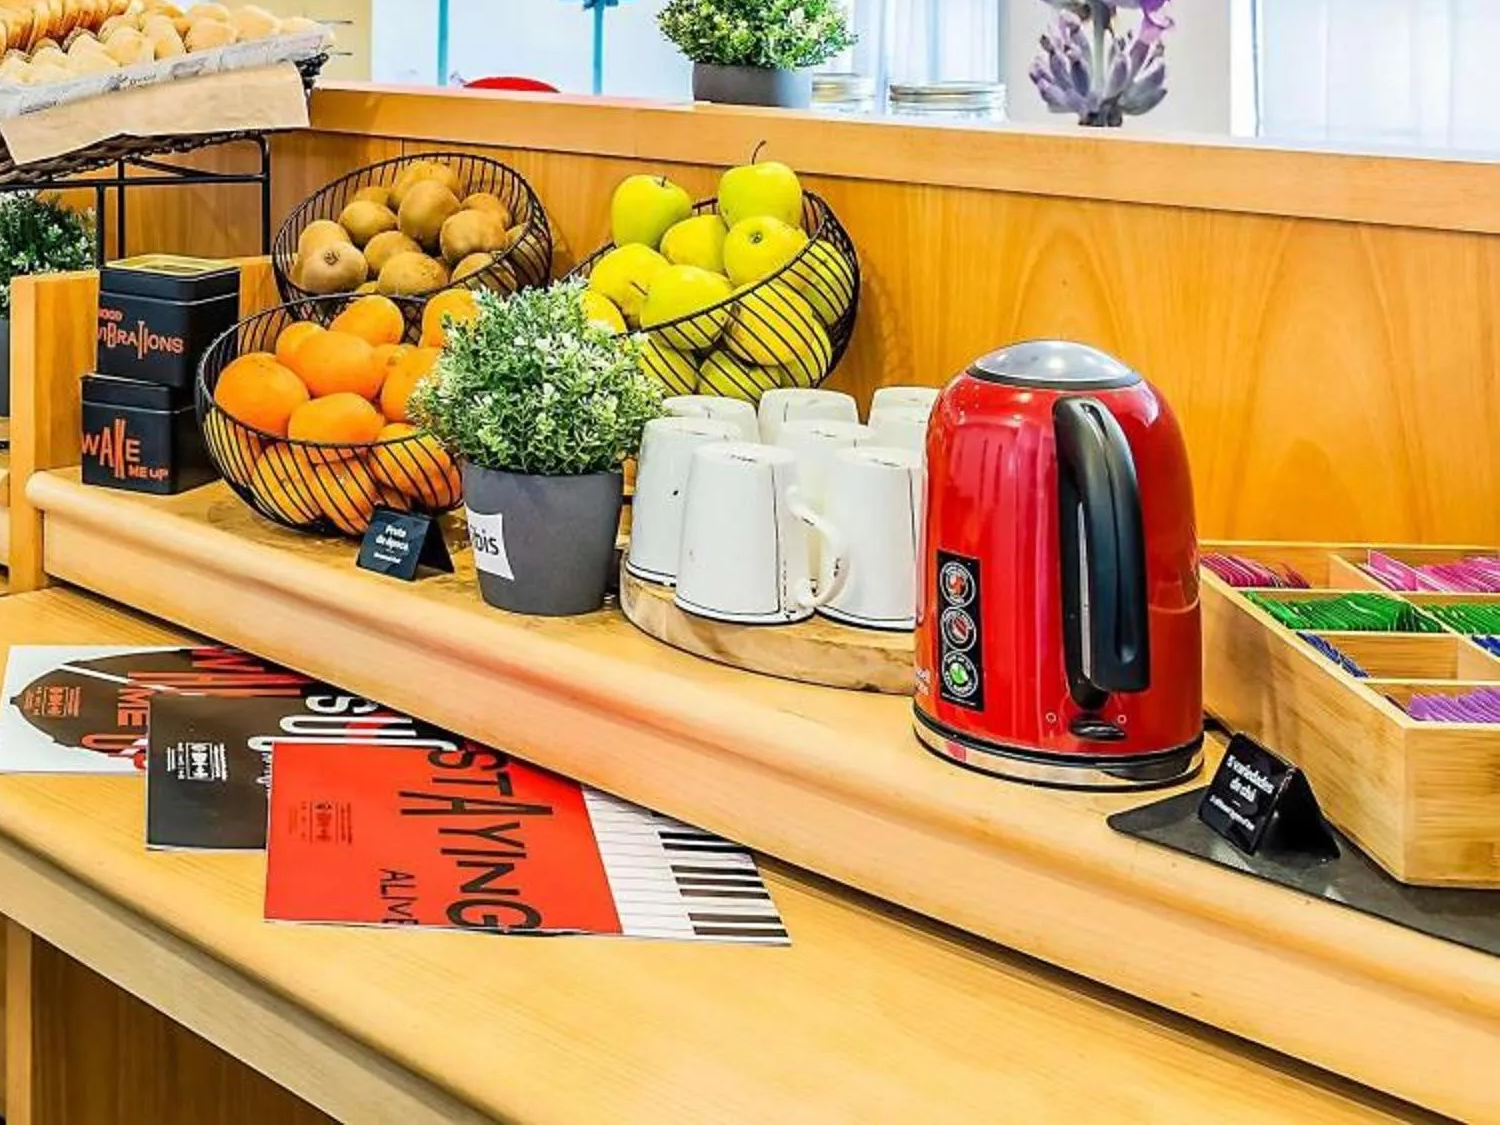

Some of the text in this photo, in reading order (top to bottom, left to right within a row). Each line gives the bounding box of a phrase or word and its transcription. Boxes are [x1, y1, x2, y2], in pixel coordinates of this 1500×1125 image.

[98, 308, 123, 322] OOD
[81, 418, 141, 480] WAKE
[128, 464, 169, 481] ME UP
[117, 688, 157, 726] ME
[399, 748, 553, 929] STAYING
